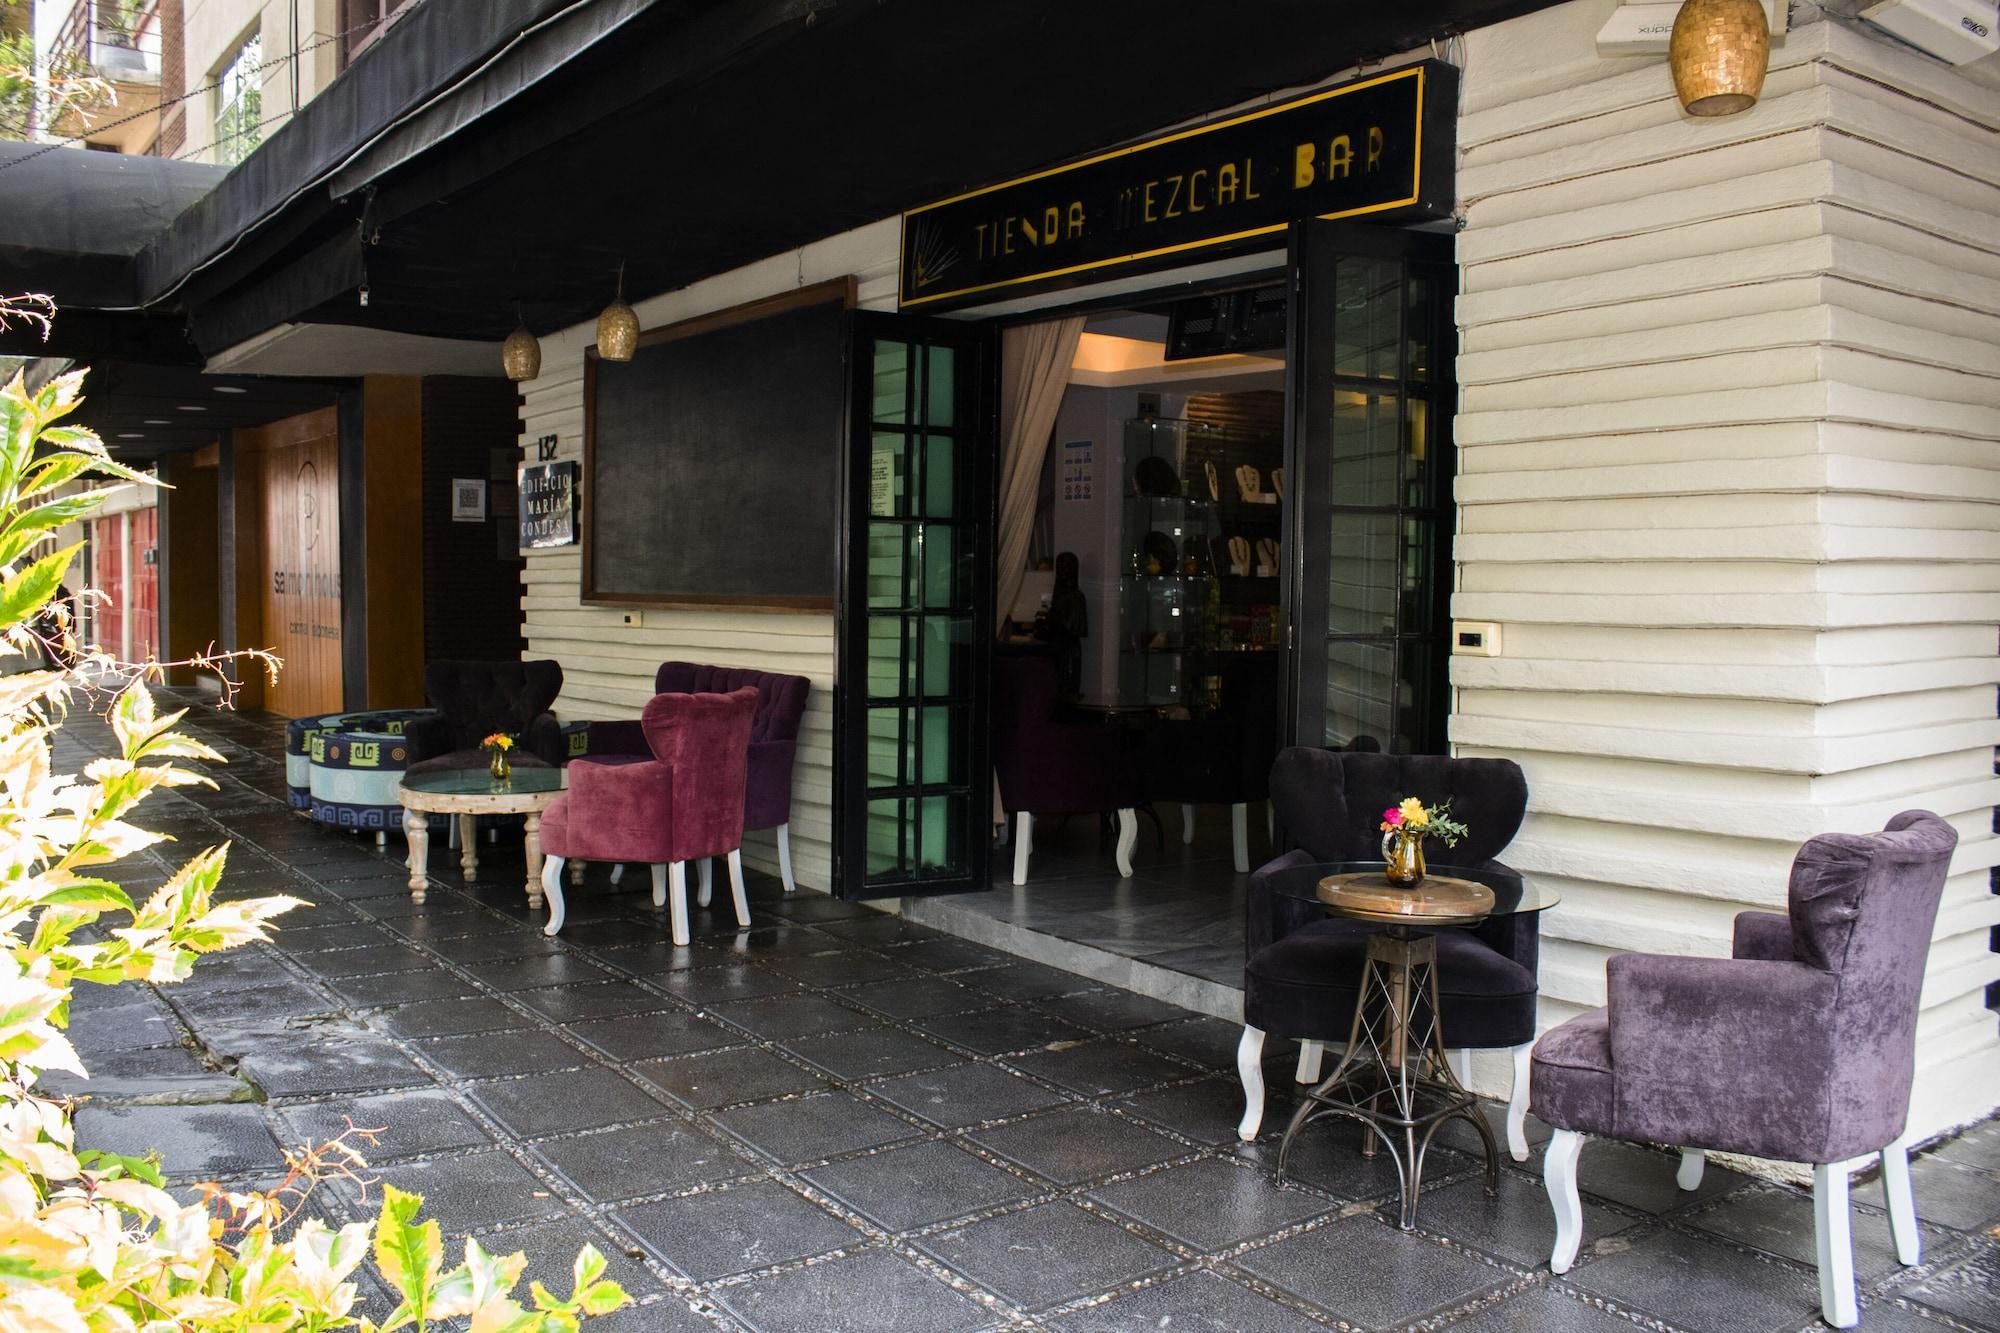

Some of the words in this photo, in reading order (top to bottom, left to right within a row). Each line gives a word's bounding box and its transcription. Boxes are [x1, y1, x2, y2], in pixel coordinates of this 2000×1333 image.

[975, 200, 1087, 261] TIENDA
[1294, 125, 1384, 189] BAR
[538, 434, 558, 462] 132
[521, 473, 570, 495] EDIFICIO
[527, 493, 562, 515] MARÍA
[521, 518, 569, 537] CONDESA
[315, 563, 341, 599] hous
